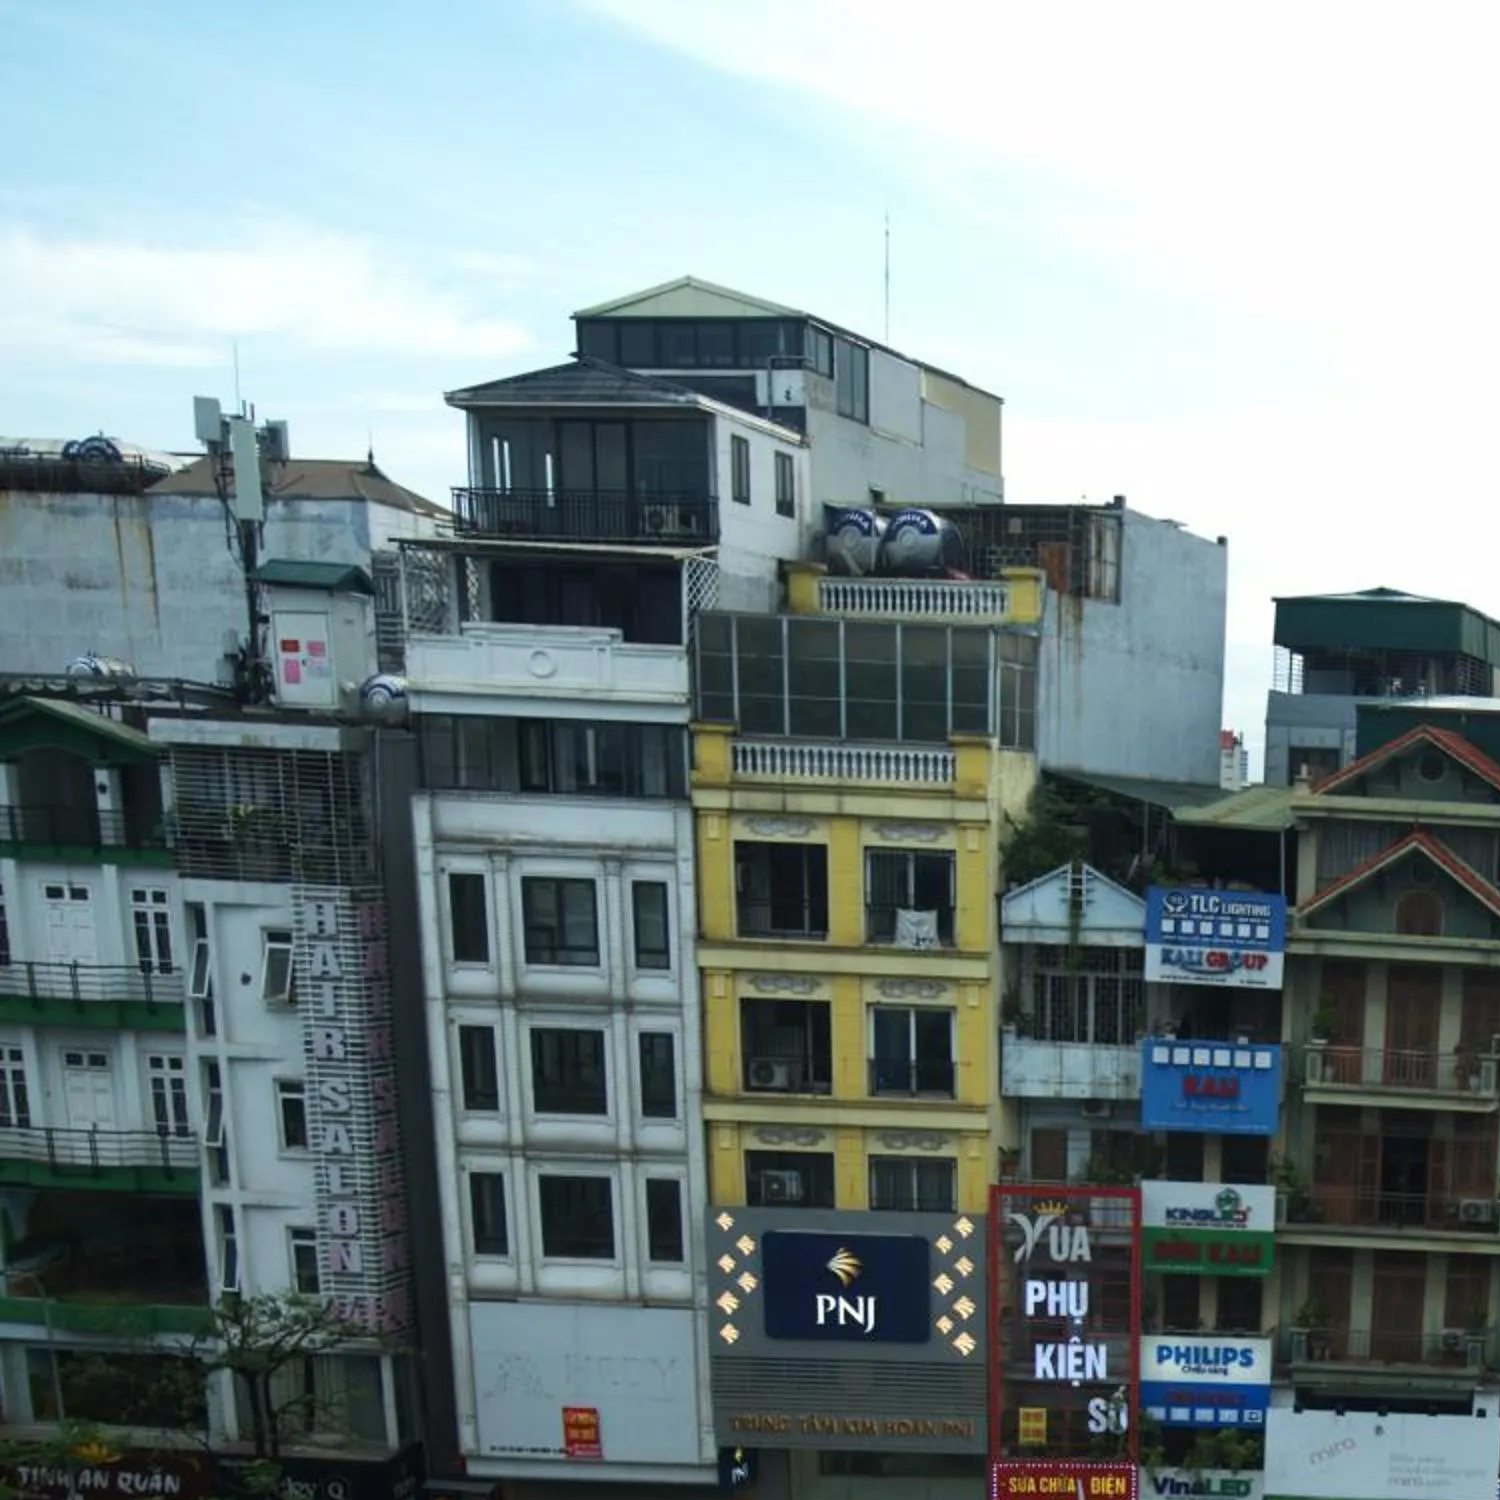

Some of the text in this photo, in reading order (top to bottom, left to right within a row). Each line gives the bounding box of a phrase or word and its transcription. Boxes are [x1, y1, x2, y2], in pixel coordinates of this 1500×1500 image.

[1010, 1213, 1092, 1264] VUA
[816, 1294, 876, 1333] PNJ
[1024, 1279, 1089, 1325] PHỤ
[1034, 1336, 1109, 1387] KIỆN
[1156, 1345, 1254, 1367] PHILIPS
[78, 1468, 110, 1489] AN
